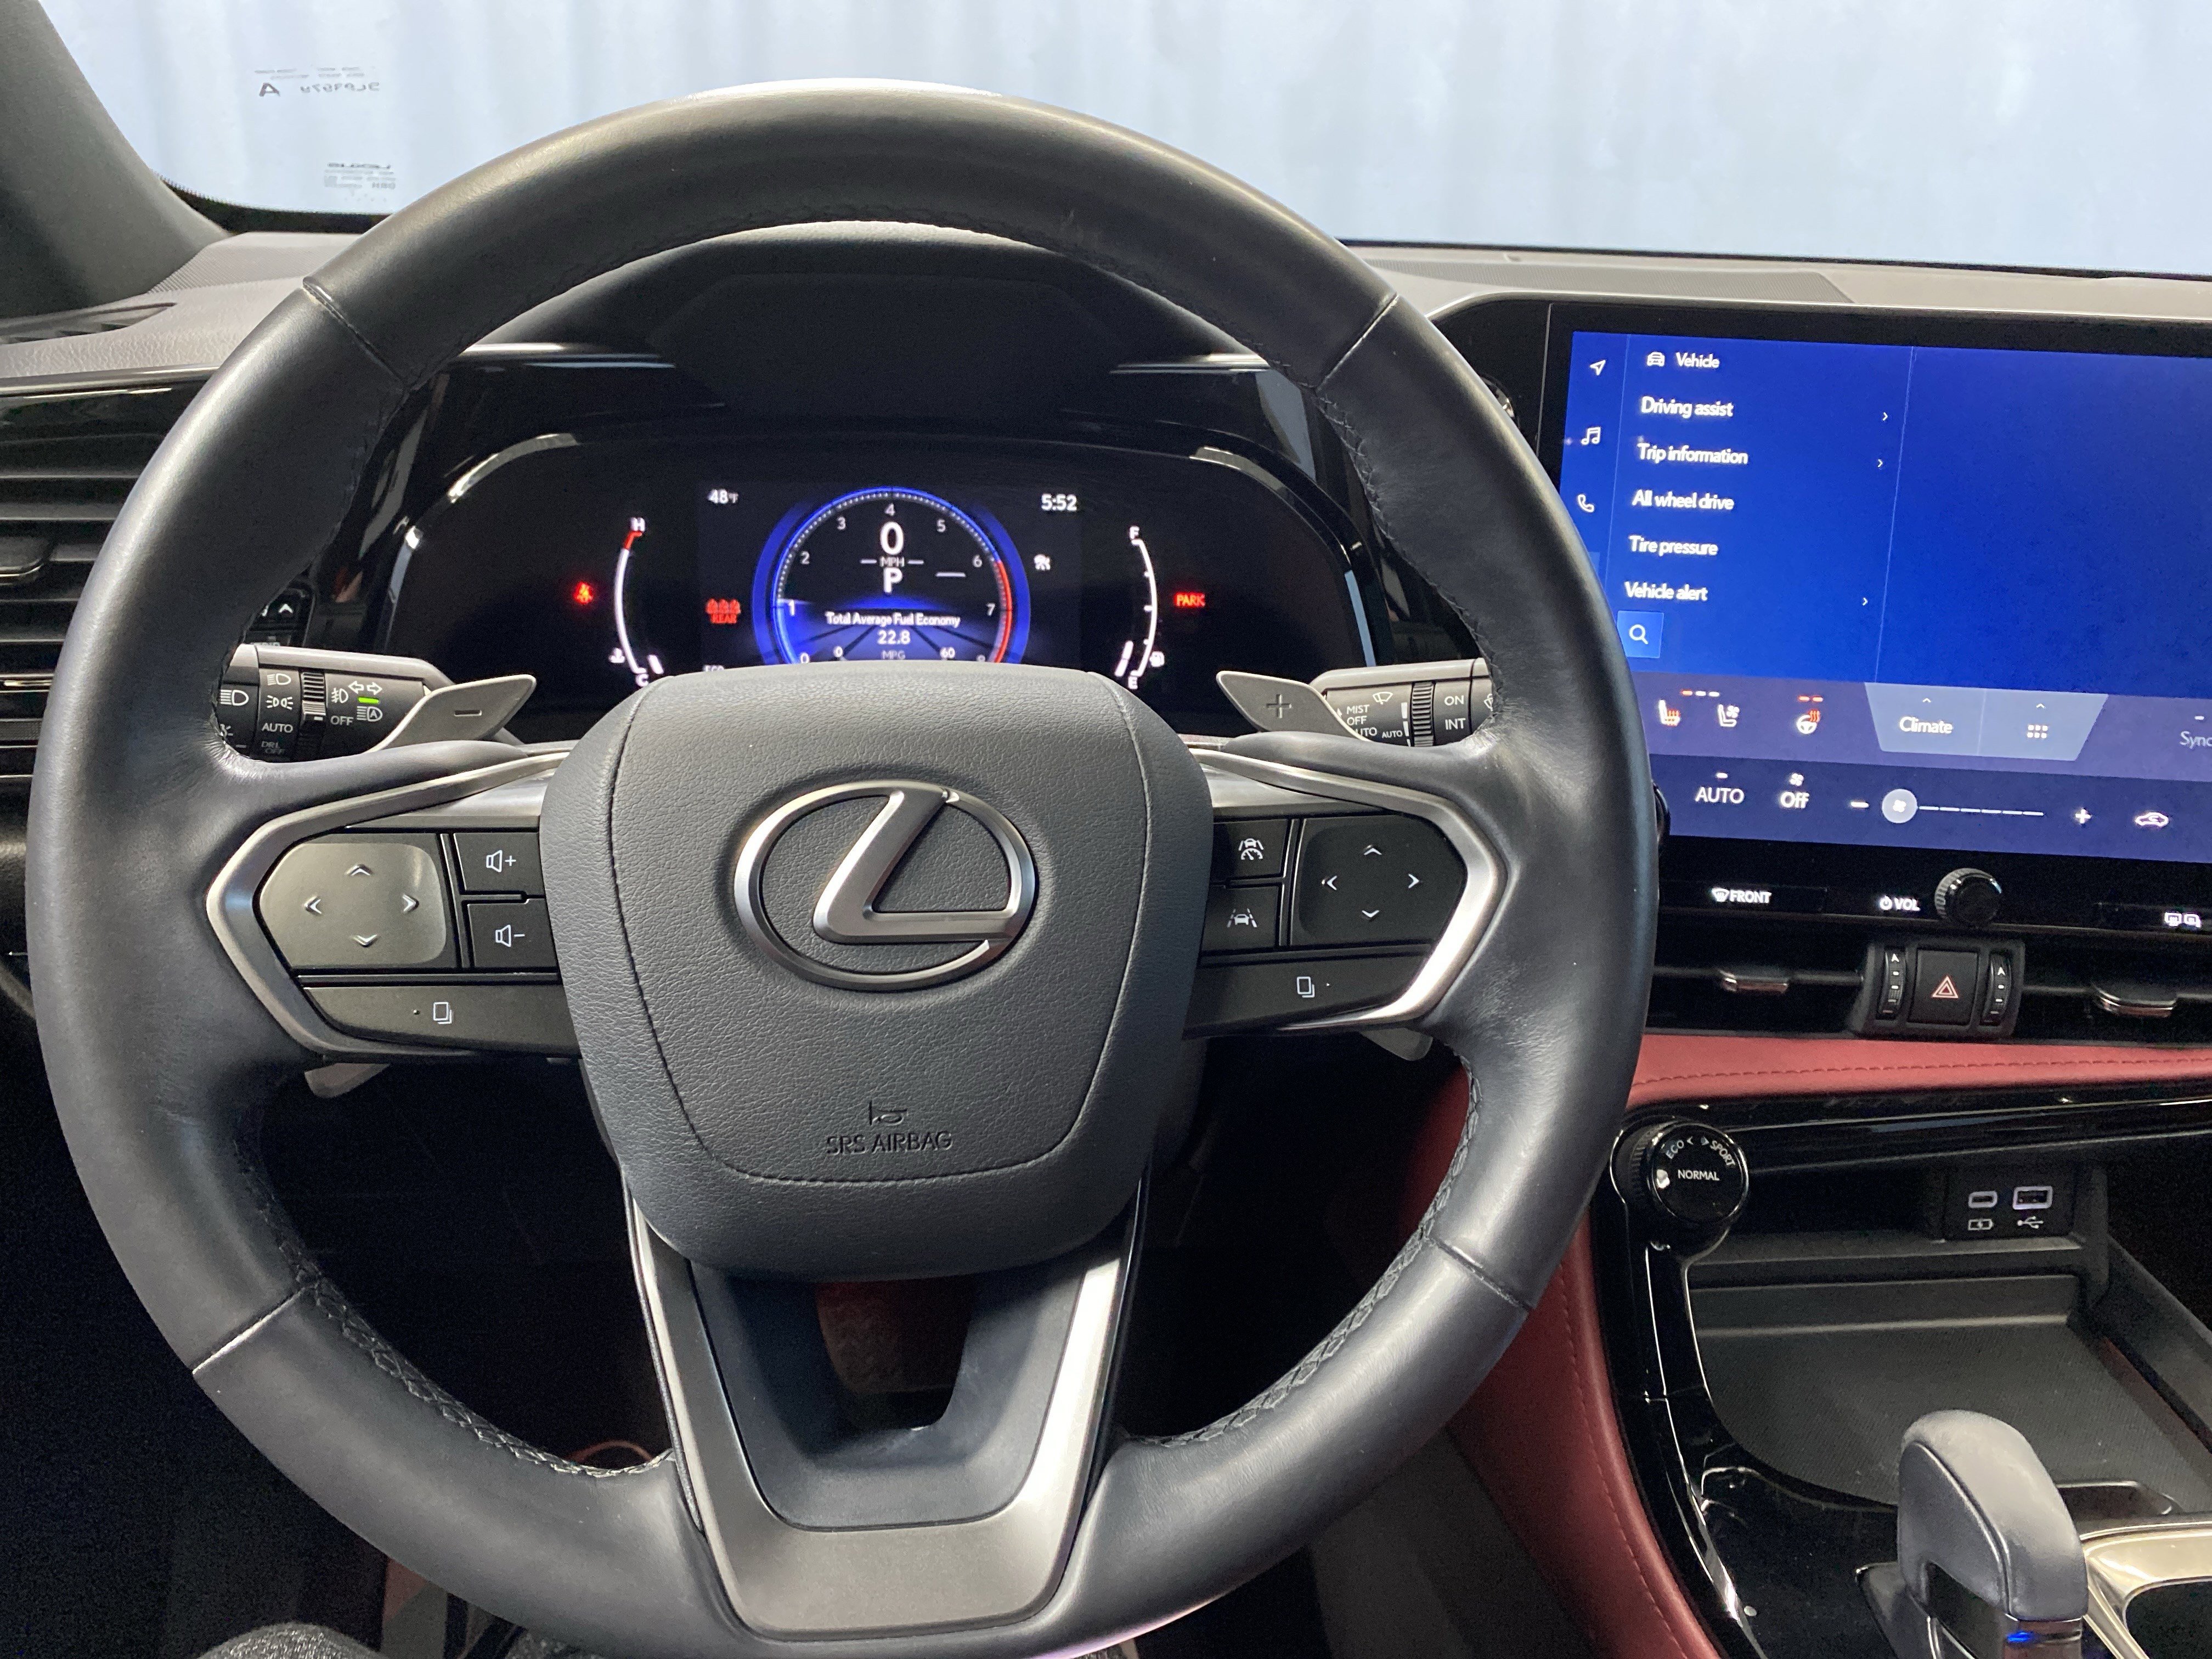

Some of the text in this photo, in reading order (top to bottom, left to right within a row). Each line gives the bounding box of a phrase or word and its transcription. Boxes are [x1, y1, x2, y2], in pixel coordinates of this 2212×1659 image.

[1675, 352, 1720, 368] Vehicle
[1641, 396, 1734, 419] Driving assist
[1637, 443, 1749, 464] Trip information
[1041, 494, 1077, 512] 5:52
[1632, 489, 1735, 510] All wheel drive
[885, 504, 895, 516] 4
[630, 517, 646, 532] H
[837, 517, 847, 530] 3
[936, 519, 946, 531] 5
[880, 521, 904, 555] 0
[1129, 526, 1140, 540] F
[1629, 535, 1719, 557] Tire pressure
[800, 551, 810, 565] 2
[880, 557, 905, 567] MPH
[972, 555, 983, 567] 6
[884, 567, 903, 594] P
[1624, 582, 1708, 601] Vehicle alert
[1175, 593, 1206, 607] PARK
[788, 602, 795, 616] 1
[986, 604, 996, 616] 7
[826, 611, 961, 628] Total Average Fuel Economy
[878, 630, 911, 645] 22.8
[834, 646, 844, 658] 0
[882, 650, 906, 660] MPG
[940, 647, 956, 658] 60
[636, 674, 648, 687] C
[1128, 676, 1138, 690] E
[1444, 695, 1465, 706] ON
[1346, 704, 1370, 715] MIST
[261, 722, 294, 733] AUTO
[331, 715, 354, 726] OFF
[1346, 715, 1367, 726] OFF
[1445, 718, 1466, 730] INT
[1899, 716, 1953, 735] Climate
[1355, 726, 1378, 737] UTO
[1382, 730, 1403, 738] AUTO
[261, 741, 280, 749] DRL
[2179, 731, 2212, 749] Sync
[1695, 786, 1745, 804] AUTO
[1780, 791, 1810, 809] Off
[1729, 889, 1773, 905] FRONT
[1893, 897, 1921, 912] VOL
[826, 1130, 953, 1155] SRS AIRBAG
[1666, 1139, 1684, 1160] ECO
[1709, 1140, 1736, 1166] SPORT
[1678, 1169, 1720, 1181] NORMAL
